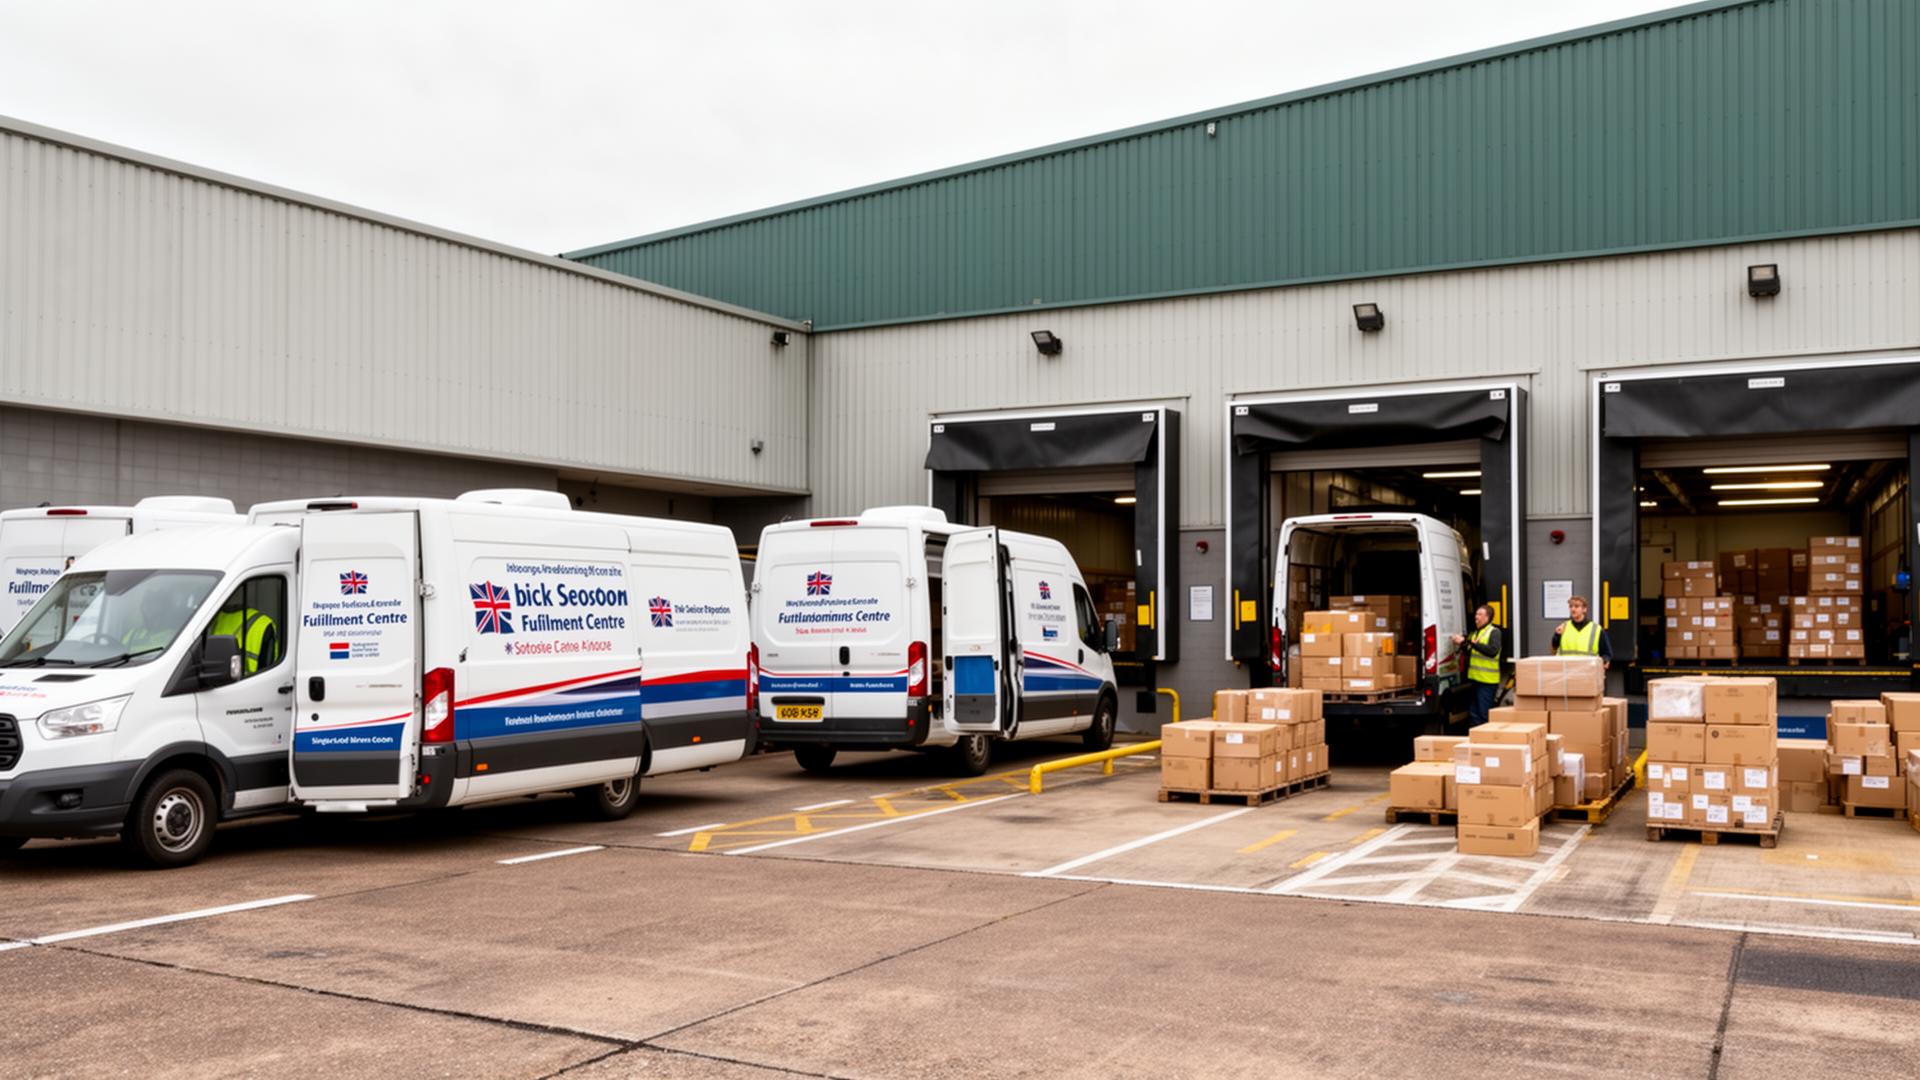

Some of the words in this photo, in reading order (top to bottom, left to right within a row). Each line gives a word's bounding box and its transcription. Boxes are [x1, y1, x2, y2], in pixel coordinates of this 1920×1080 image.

[366, 612, 408, 625] Centre
[586, 613, 625, 630] Centre
[856, 610, 891, 622] Centre
